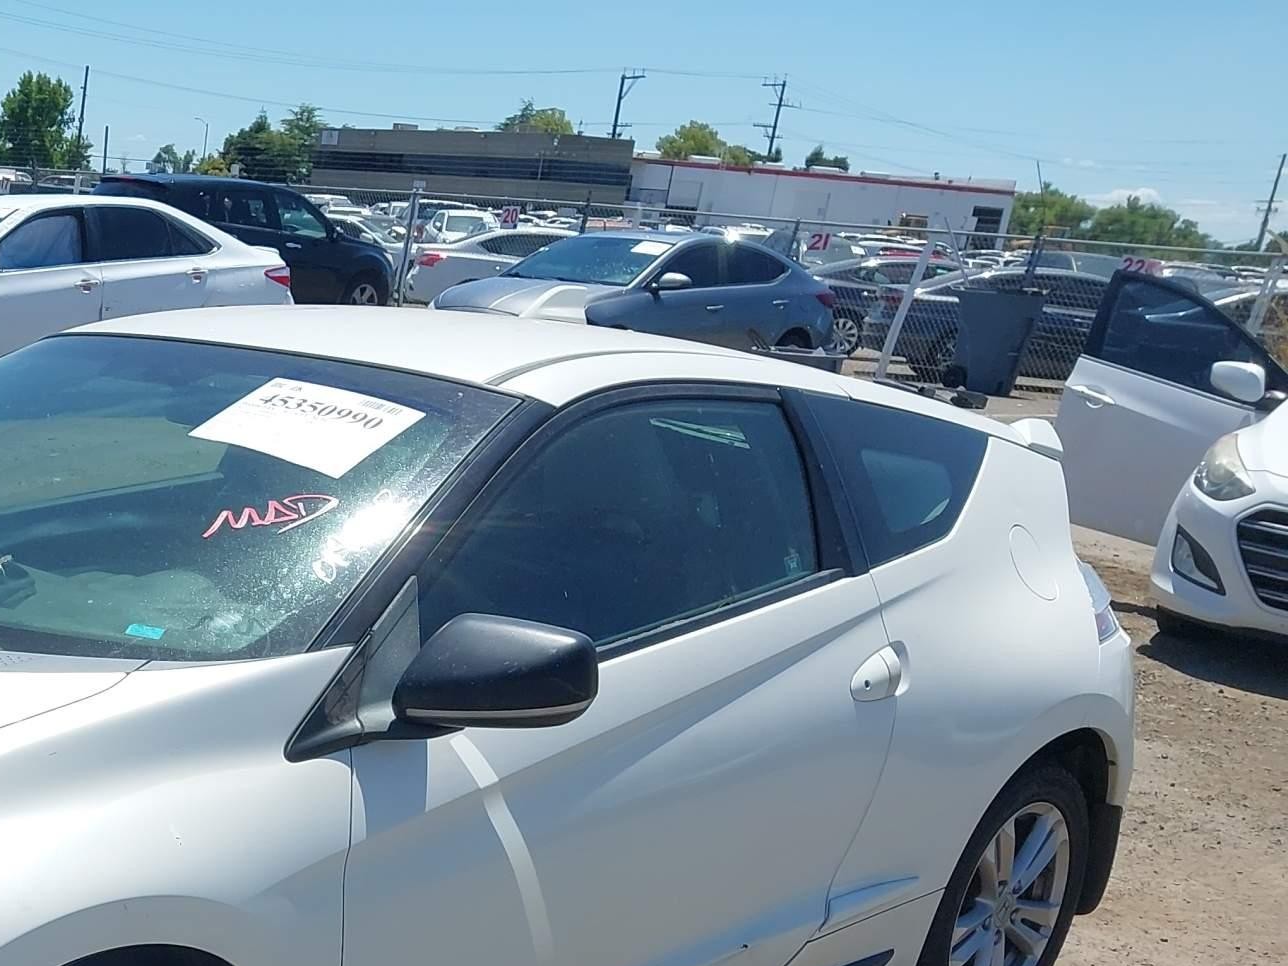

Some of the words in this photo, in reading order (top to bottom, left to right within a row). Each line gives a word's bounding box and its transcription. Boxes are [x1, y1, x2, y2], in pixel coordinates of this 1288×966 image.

[503, 208, 518, 223] 20
[807, 233, 830, 250] 21
[259, 394, 384, 429] 45350990
